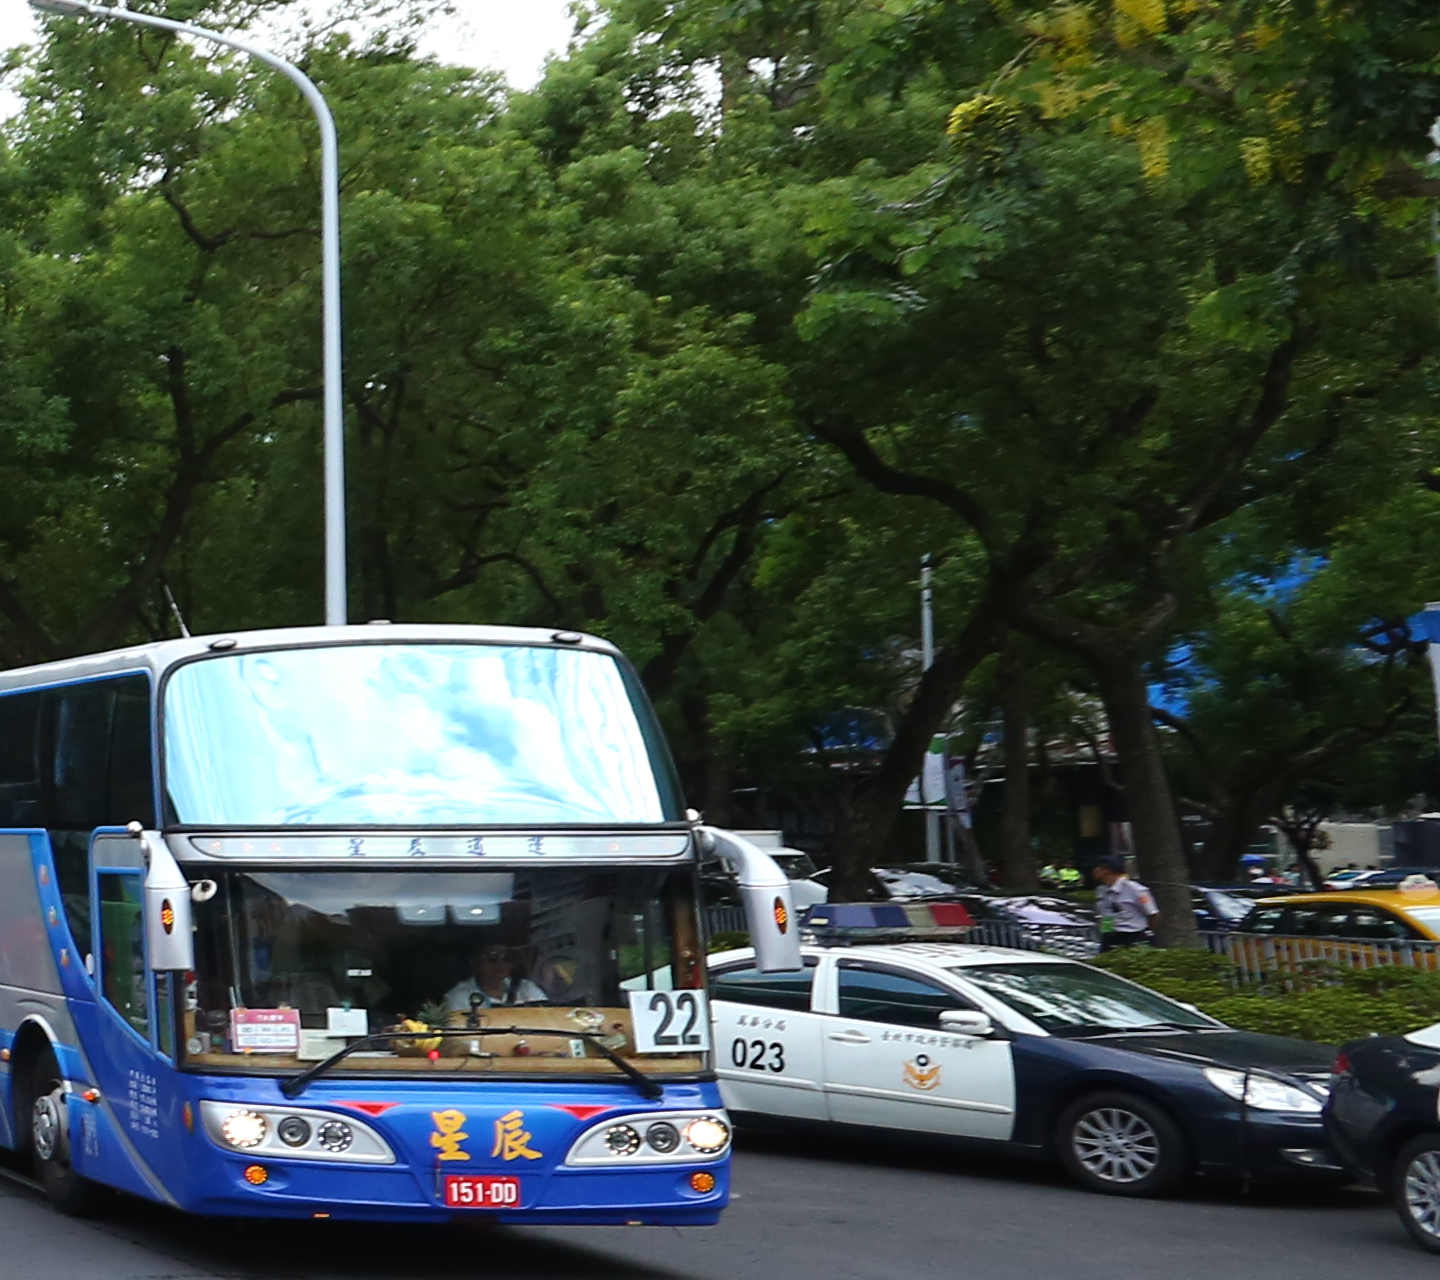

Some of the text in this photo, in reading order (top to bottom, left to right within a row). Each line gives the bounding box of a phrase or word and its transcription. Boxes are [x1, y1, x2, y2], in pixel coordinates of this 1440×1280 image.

[647, 992, 701, 1047] 22
[731, 1037, 786, 1073] 023
[430, 1108, 544, 1162] 星辰
[449, 1181, 517, 1204] 151-DD
